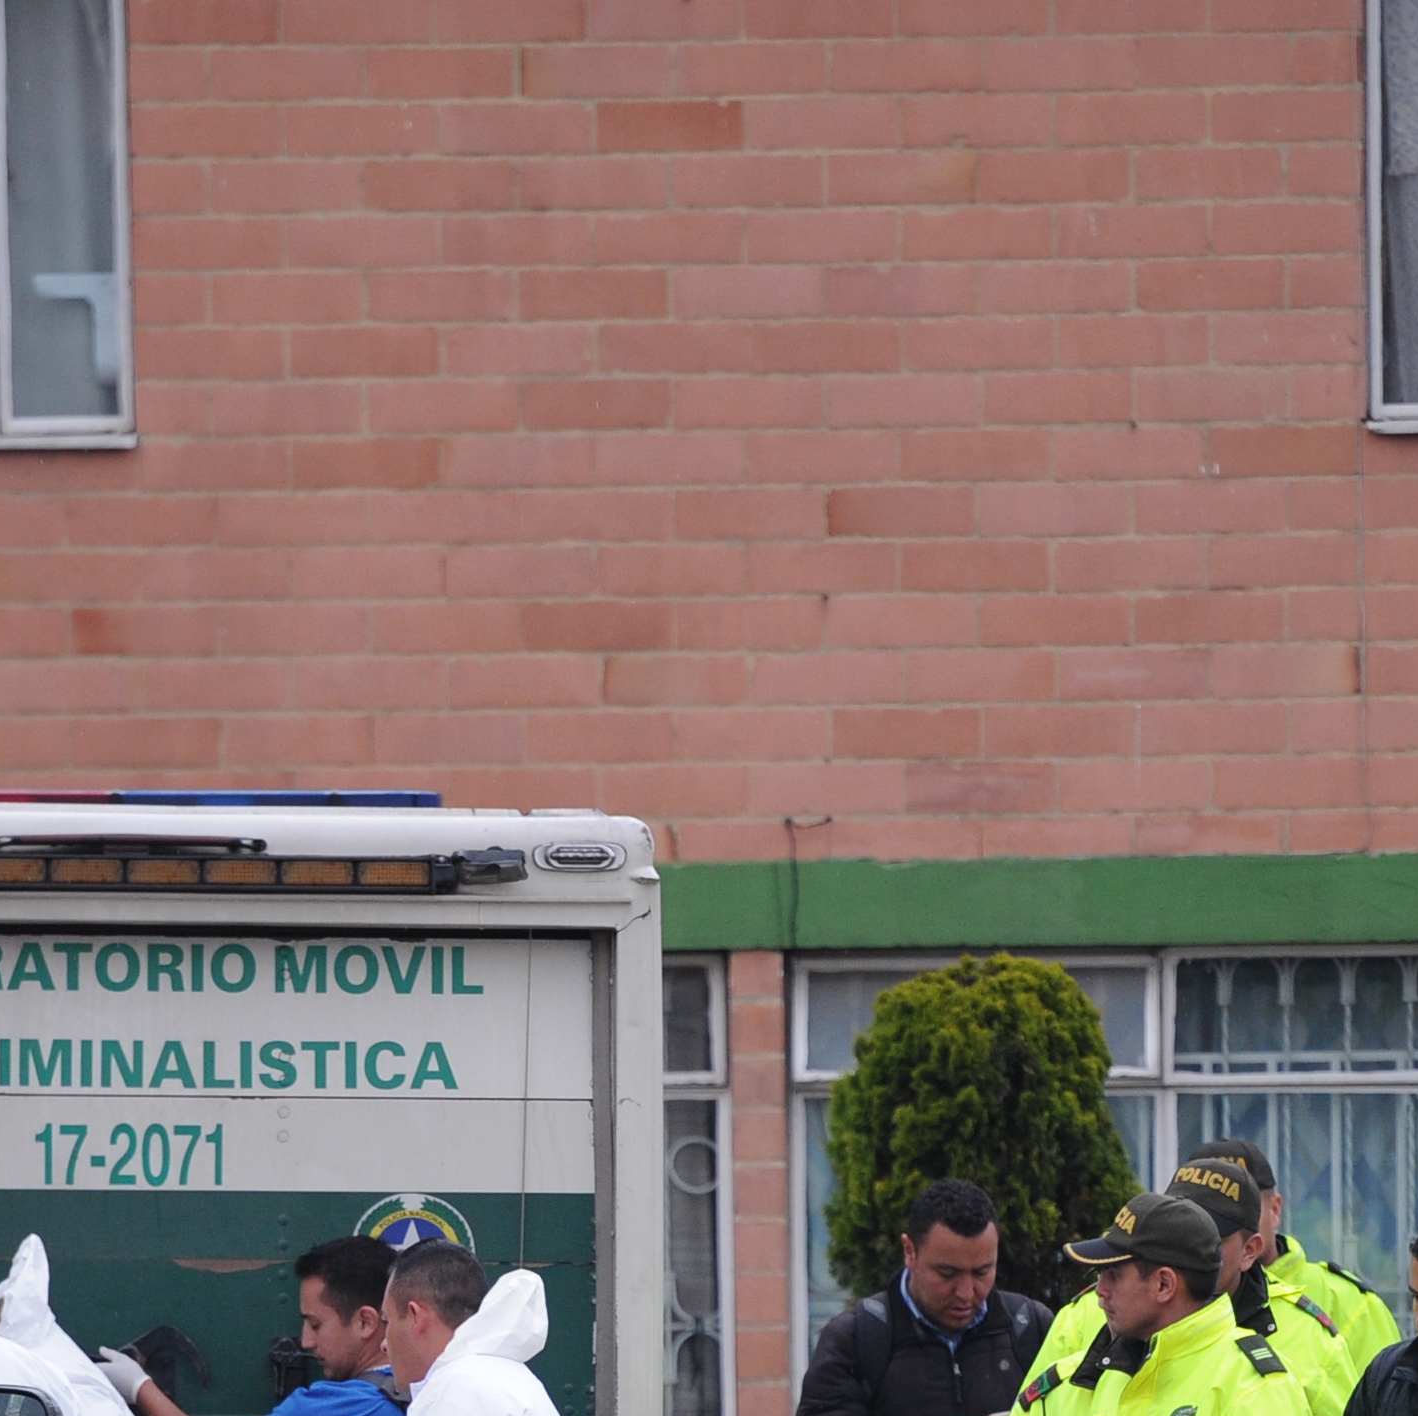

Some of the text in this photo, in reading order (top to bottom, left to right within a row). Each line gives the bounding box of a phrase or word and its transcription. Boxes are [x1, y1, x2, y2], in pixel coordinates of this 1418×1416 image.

[274, 943, 485, 996] MOVIL
[34, 1122, 224, 1188] 17-2071
[1174, 1166, 1241, 1203] POLICIA
